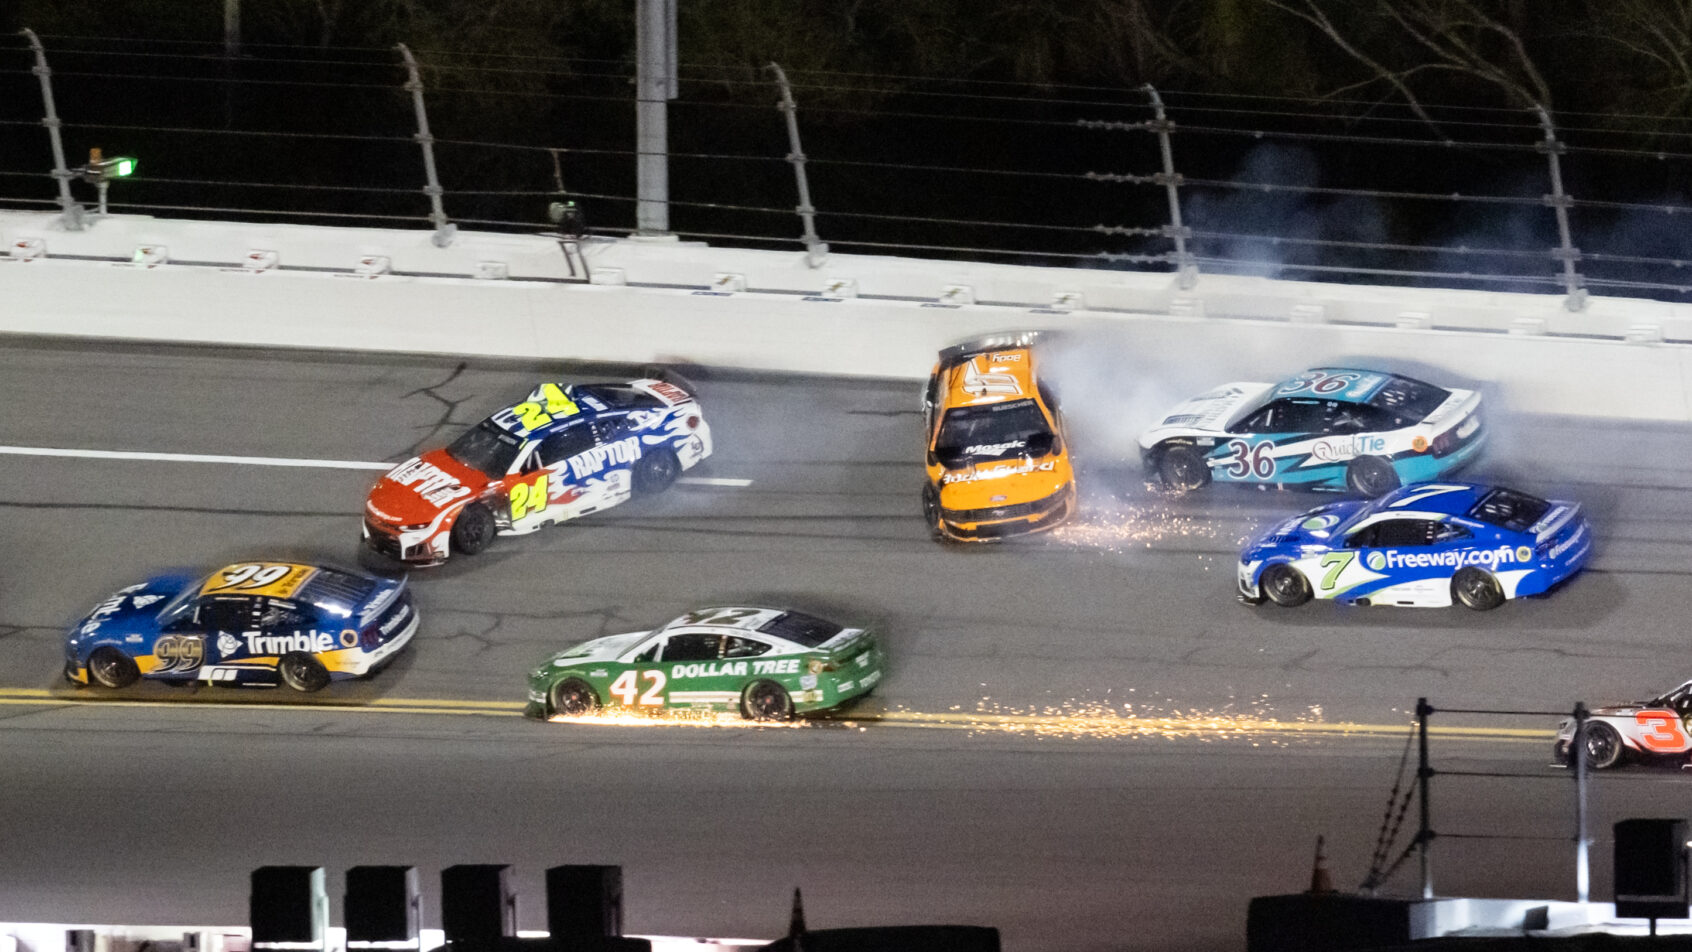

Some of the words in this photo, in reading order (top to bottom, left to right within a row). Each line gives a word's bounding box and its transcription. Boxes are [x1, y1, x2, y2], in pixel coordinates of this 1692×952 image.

[1277, 371, 1360, 395] 36
[513, 383, 580, 432] 24
[568, 436, 642, 480] RAPTOR
[965, 440, 1026, 454] Mosaic
[1228, 439, 1275, 480] 36
[1312, 436, 1385, 461] QuickTie
[510, 475, 549, 521] 24
[1389, 485, 1471, 508] 7
[1319, 551, 1355, 591] 7
[1387, 547, 1516, 571] Freeway.com
[209, 563, 292, 591] 99
[151, 635, 204, 673] 99
[243, 630, 334, 655] Trimble
[671, 661, 748, 679] DOLLAR
[752, 659, 801, 675] TREE
[610, 670, 667, 705] 42
[1635, 710, 1686, 753] 3
